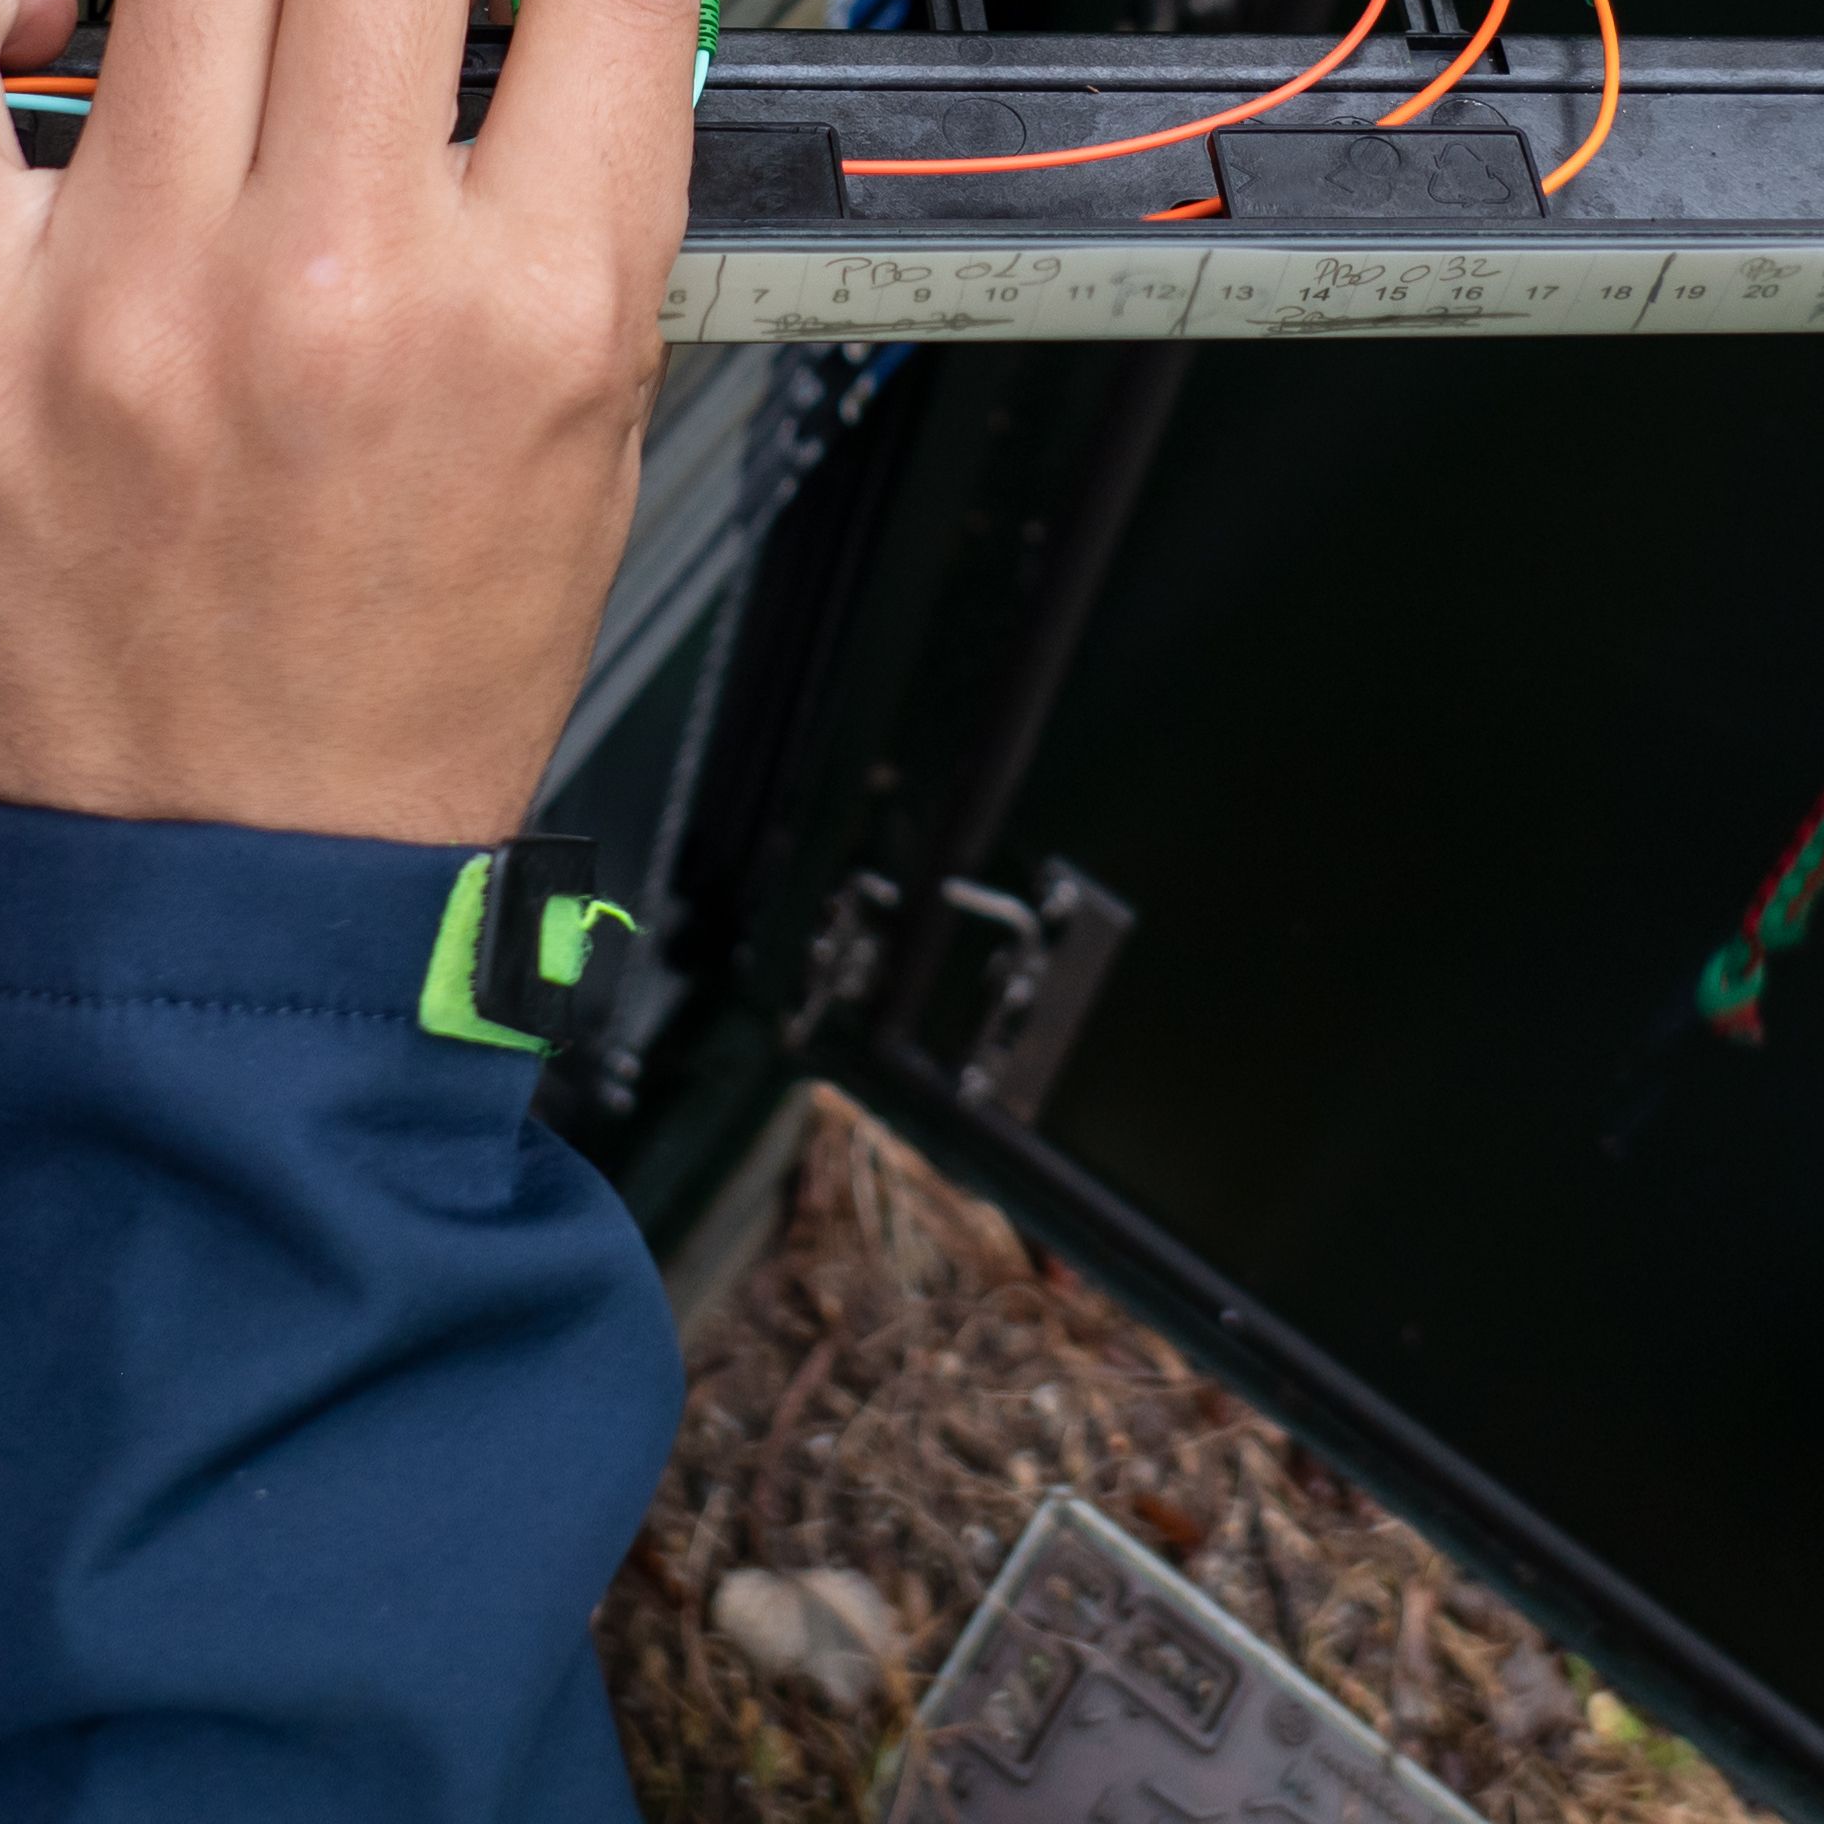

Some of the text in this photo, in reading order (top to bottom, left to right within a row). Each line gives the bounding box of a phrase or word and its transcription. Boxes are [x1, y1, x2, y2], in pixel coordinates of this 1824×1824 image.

[753, 284, 1707, 304] 7 8 9 10 11 13 14 15 16 17 18 19
